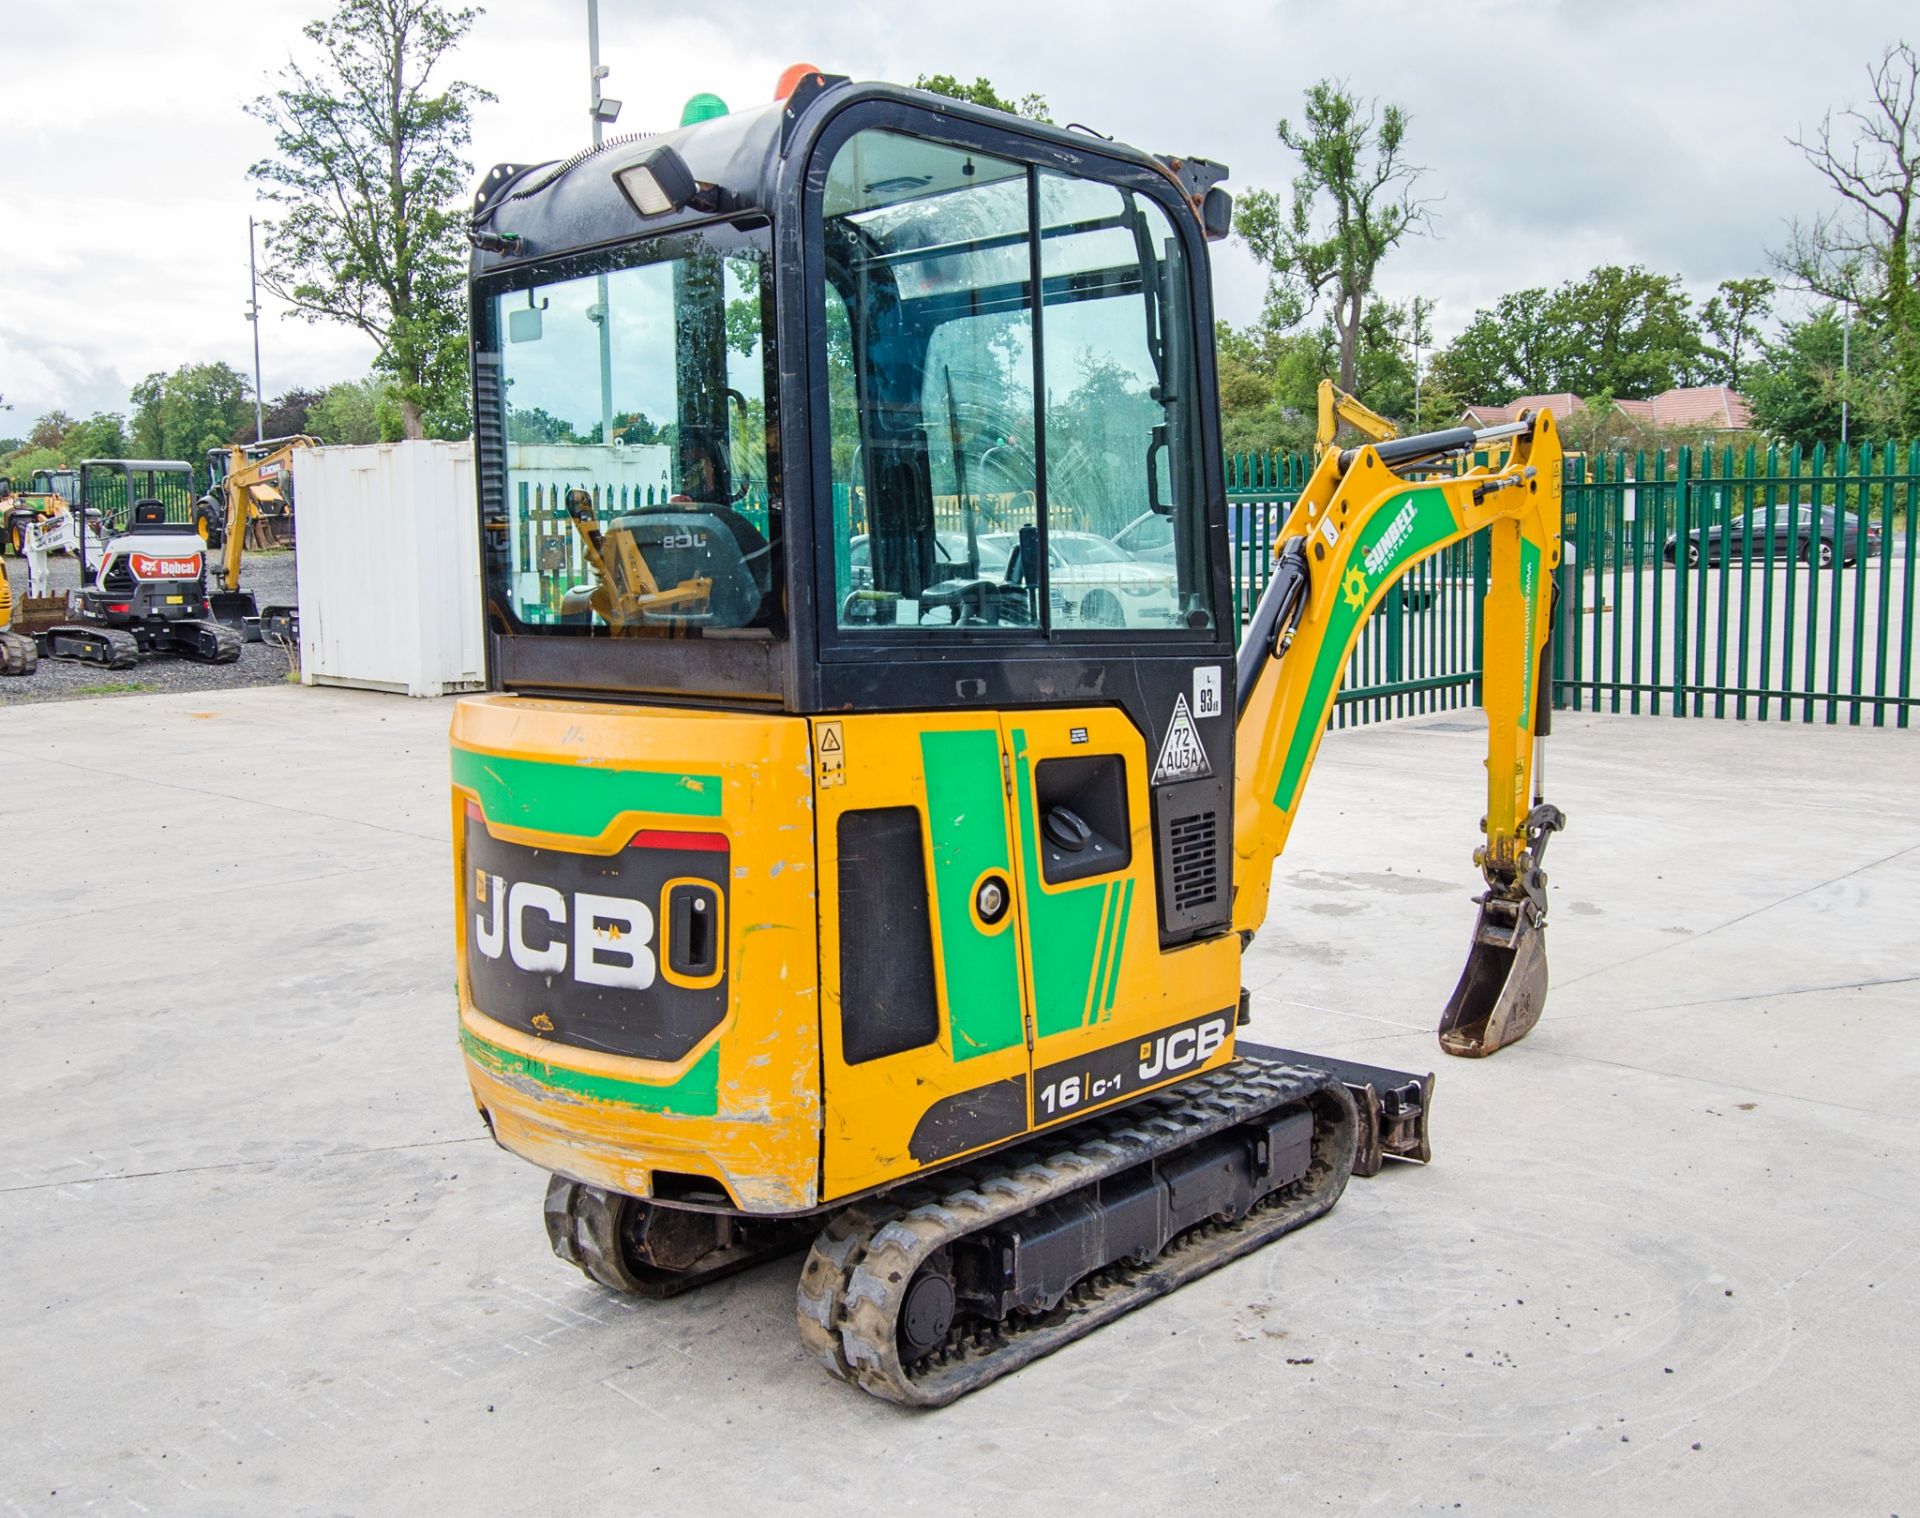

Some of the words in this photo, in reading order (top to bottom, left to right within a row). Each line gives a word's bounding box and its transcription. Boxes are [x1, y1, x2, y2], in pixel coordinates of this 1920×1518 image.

[1364, 498, 1416, 576] SUNBELT
[1377, 524, 1413, 575] RENTALS
[160, 561, 195, 575] Bobcat
[1166, 748, 1199, 771] AU3A
[1174, 727, 1190, 748] 72
[476, 870, 656, 990] JCB
[1138, 1018, 1226, 1080] JCB
[1040, 1075, 1081, 1114] 16
[1092, 1073, 1122, 1098] C-1
